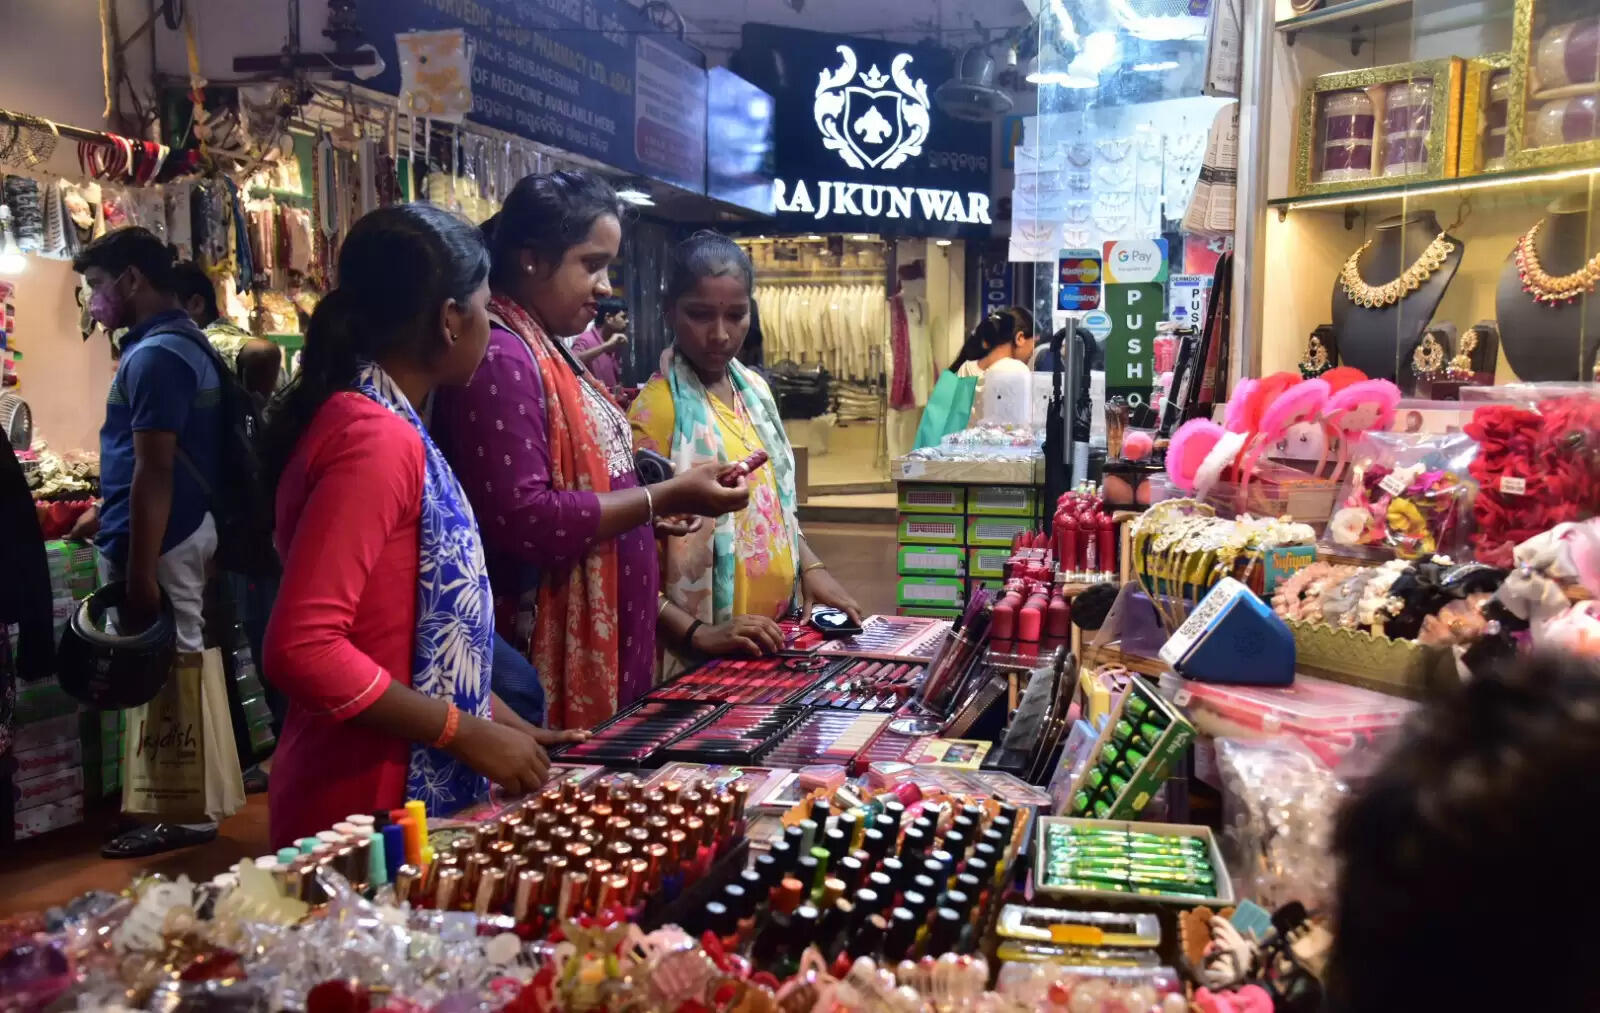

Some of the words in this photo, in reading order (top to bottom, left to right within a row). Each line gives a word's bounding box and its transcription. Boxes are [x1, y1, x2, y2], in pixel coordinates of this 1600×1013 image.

[472, 66, 489, 87] OF
[491, 72, 544, 107] MEDICINE
[544, 94, 593, 128] AVAILABLE
[1132, 250, 1152, 264] Pay
[1127, 289, 1143, 379] PUSH
